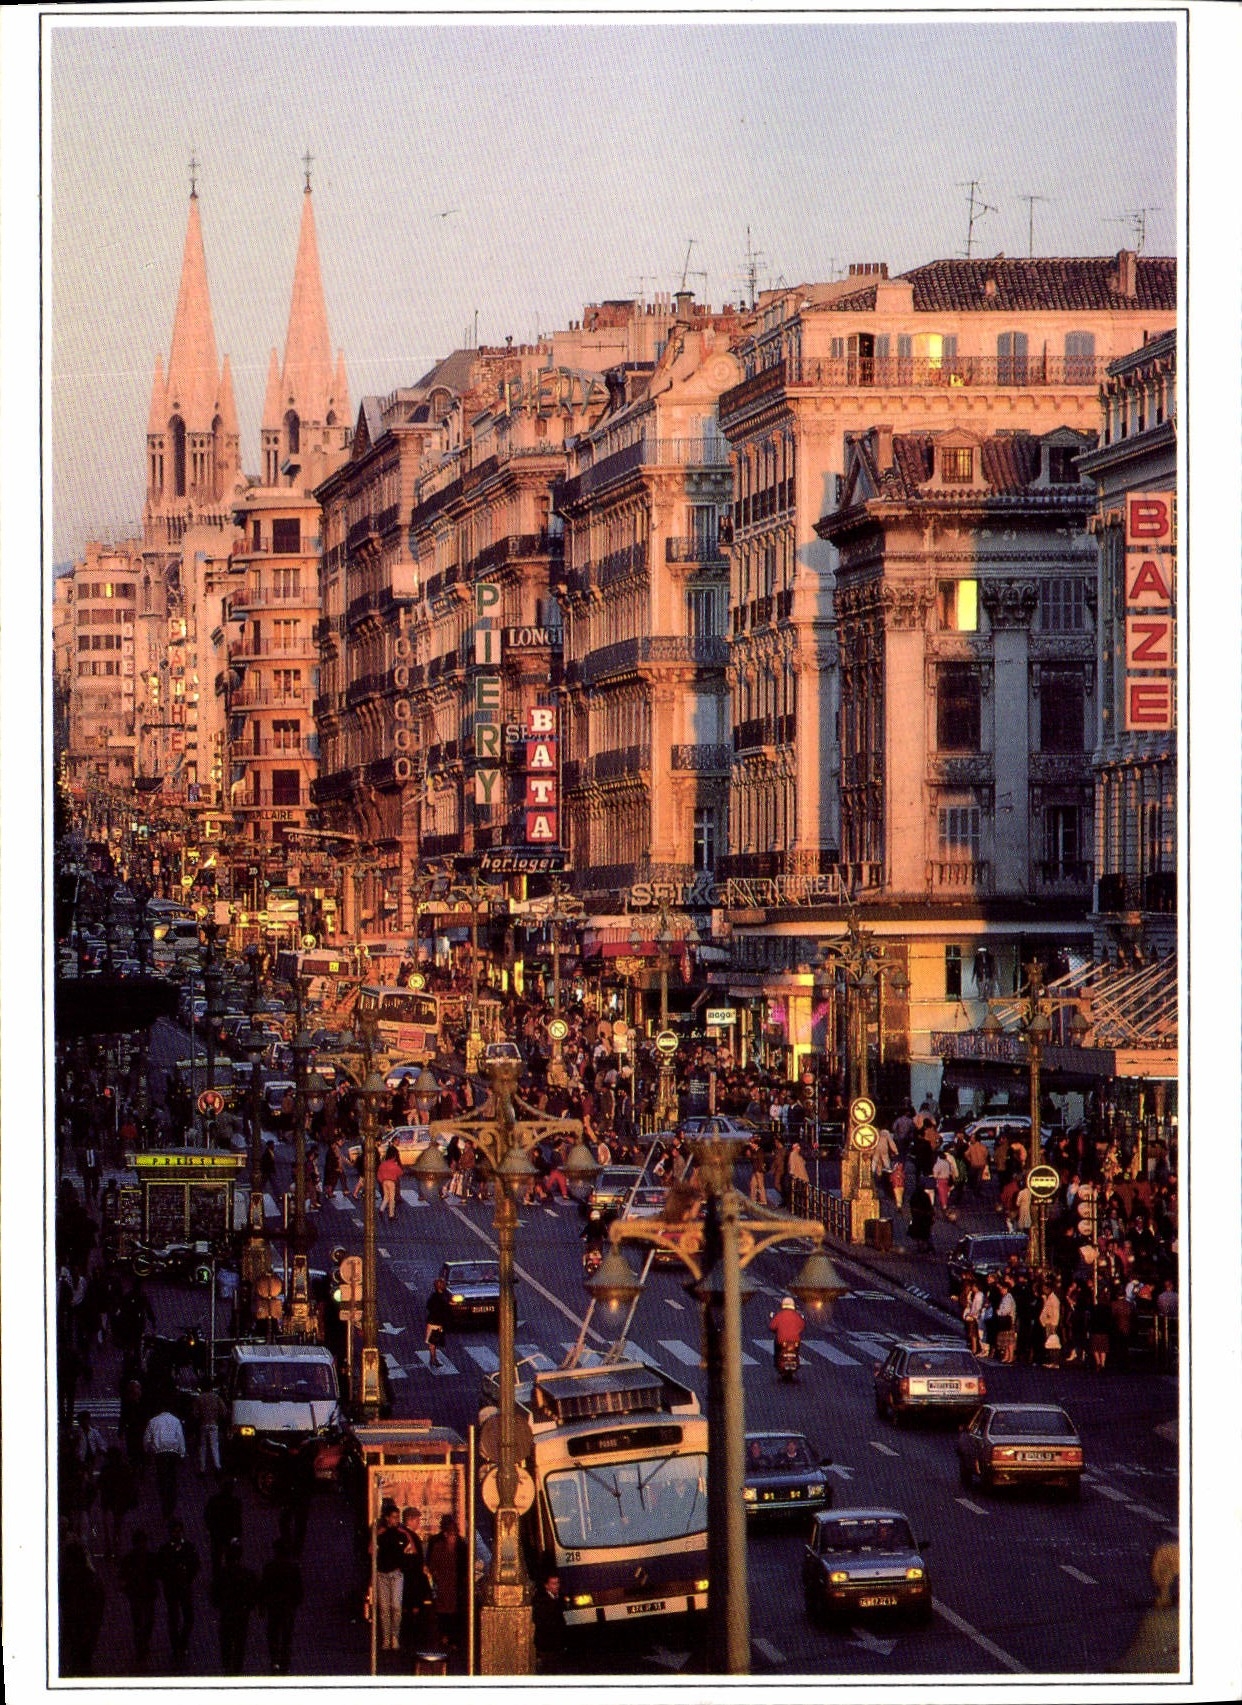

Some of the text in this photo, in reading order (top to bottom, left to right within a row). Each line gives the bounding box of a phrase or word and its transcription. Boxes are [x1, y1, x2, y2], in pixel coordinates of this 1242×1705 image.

[1129, 499, 1171, 723] BAZE
[477, 583, 500, 804] PIERY
[530, 708, 554, 839] BATA
[480, 853, 560, 874] horloger
[153, 1157, 214, 1166] PRESSE
